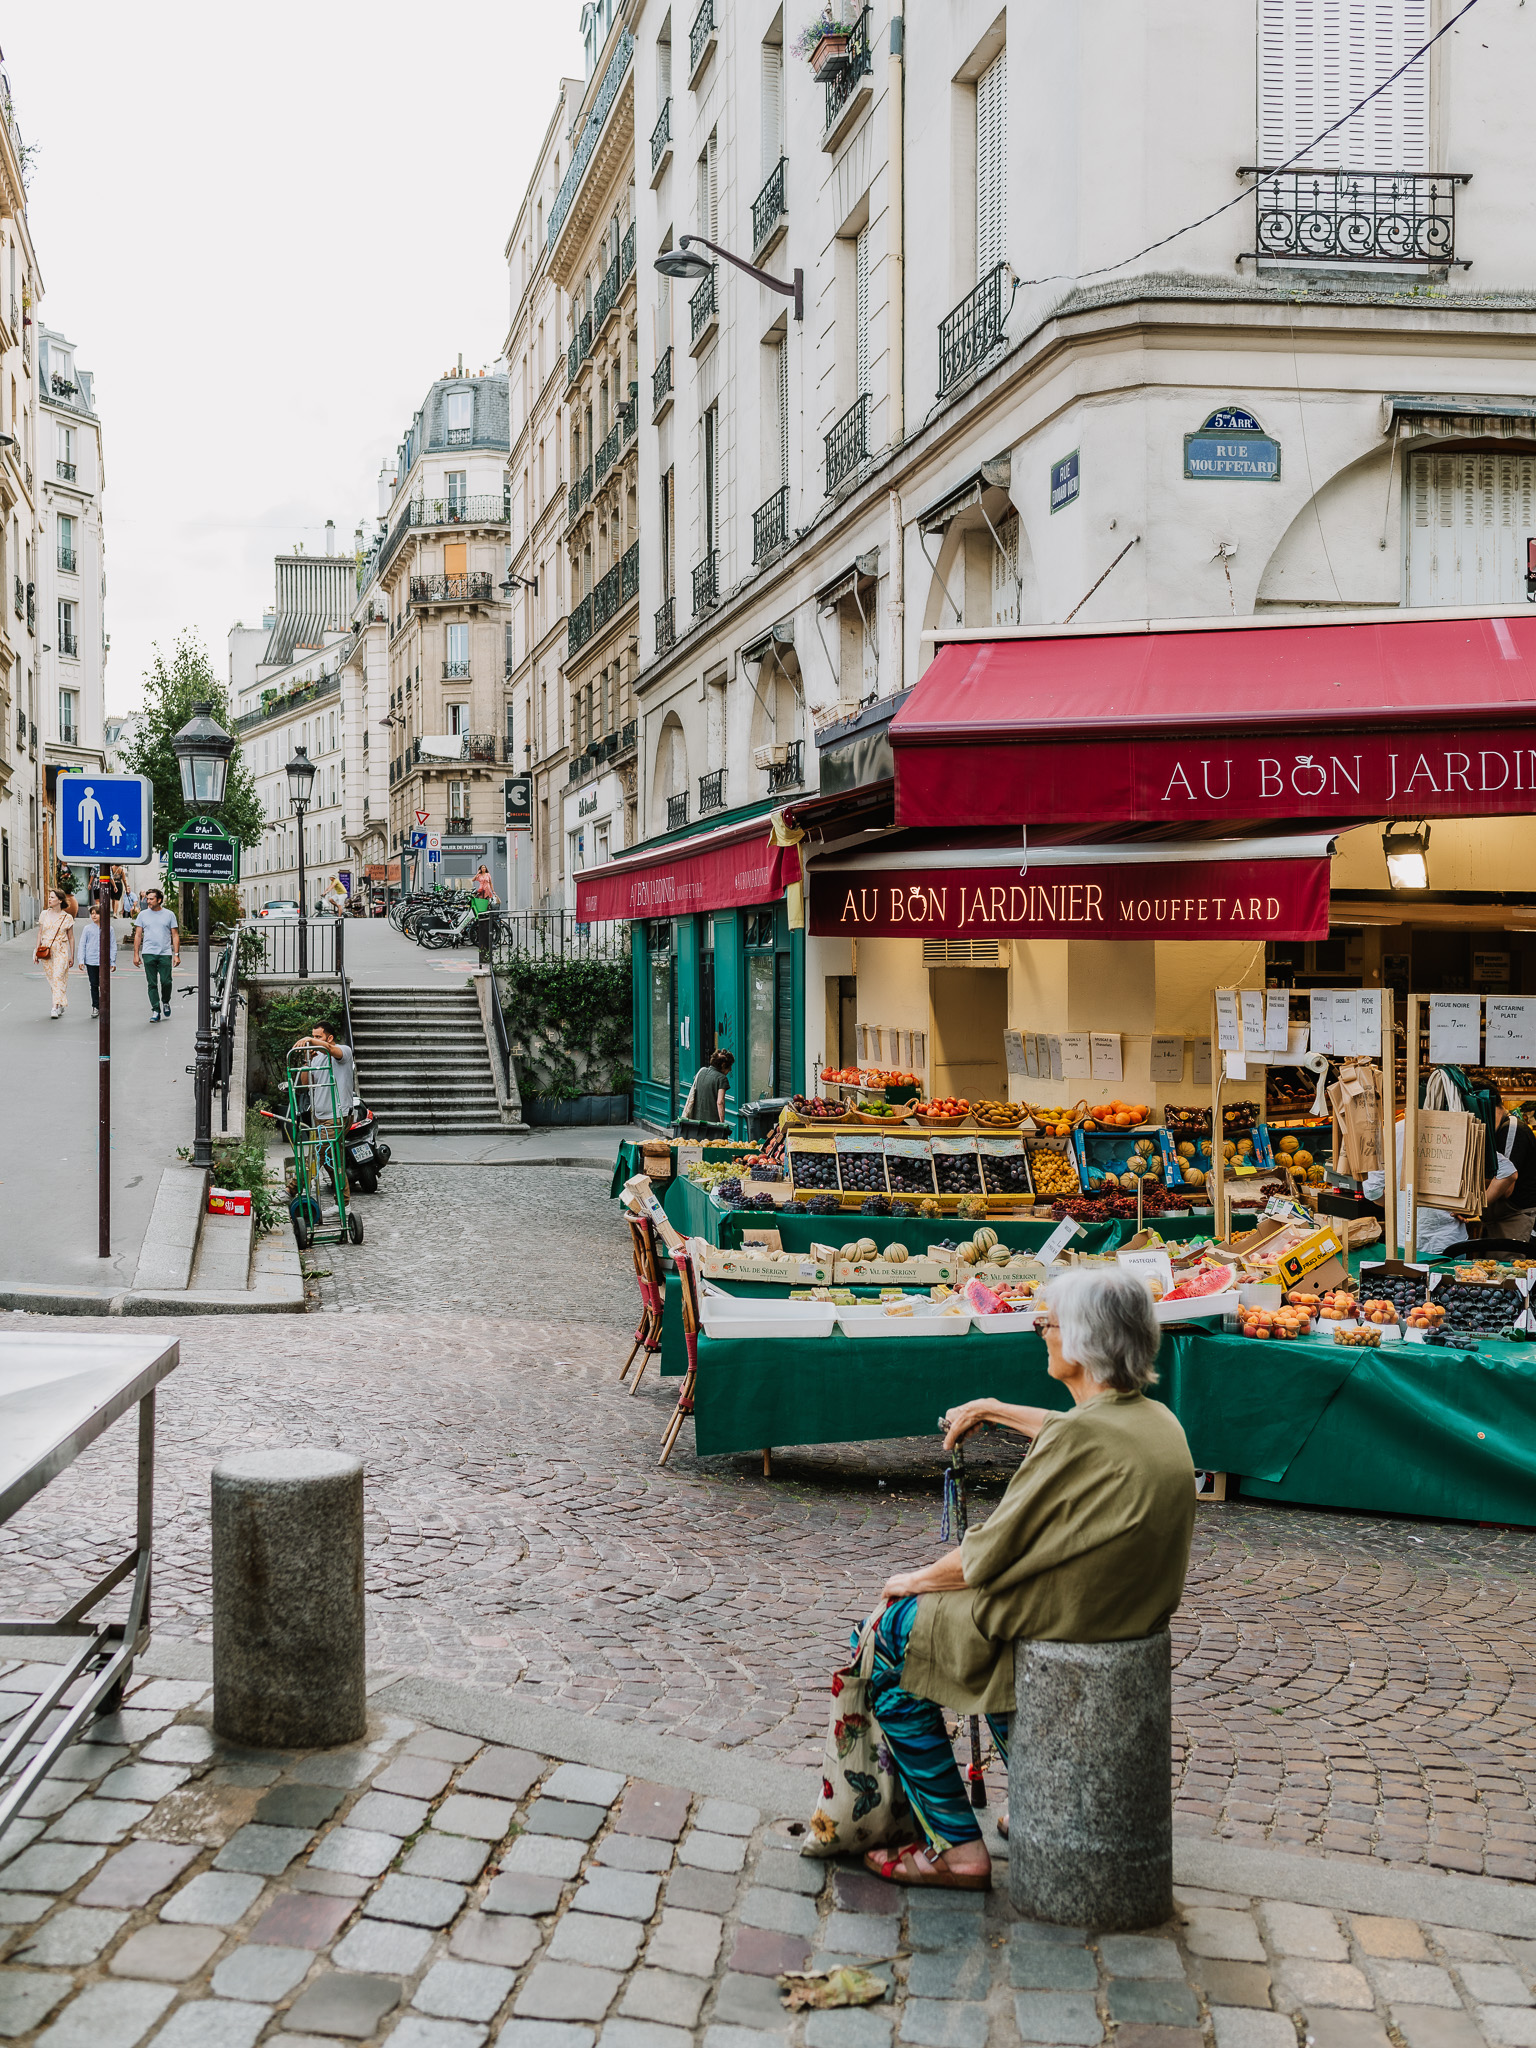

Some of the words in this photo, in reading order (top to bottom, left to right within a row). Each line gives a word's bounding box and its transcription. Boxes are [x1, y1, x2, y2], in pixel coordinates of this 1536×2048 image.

[1216, 445, 1248, 457] RUE
[1190, 459, 1277, 474] MOUFFETARD
[1161, 760, 1233, 801] AU
[1258, 755, 1363, 797] BON
[1386, 750, 1536, 801] JARDI
[193, 842, 213, 851] PLACE
[173, 851, 202, 860] GEORGES
[202, 853, 232, 862] MOUSTAKI
[840, 889, 879, 922] AU
[890, 886, 947, 922] BON
[957, 885, 1104, 928] JARDINIER
[1119, 898, 1281, 922] MOUFFETARD
[1420, 1133, 1433, 1143] AU
[739, 1265, 751, 1273] VAL
